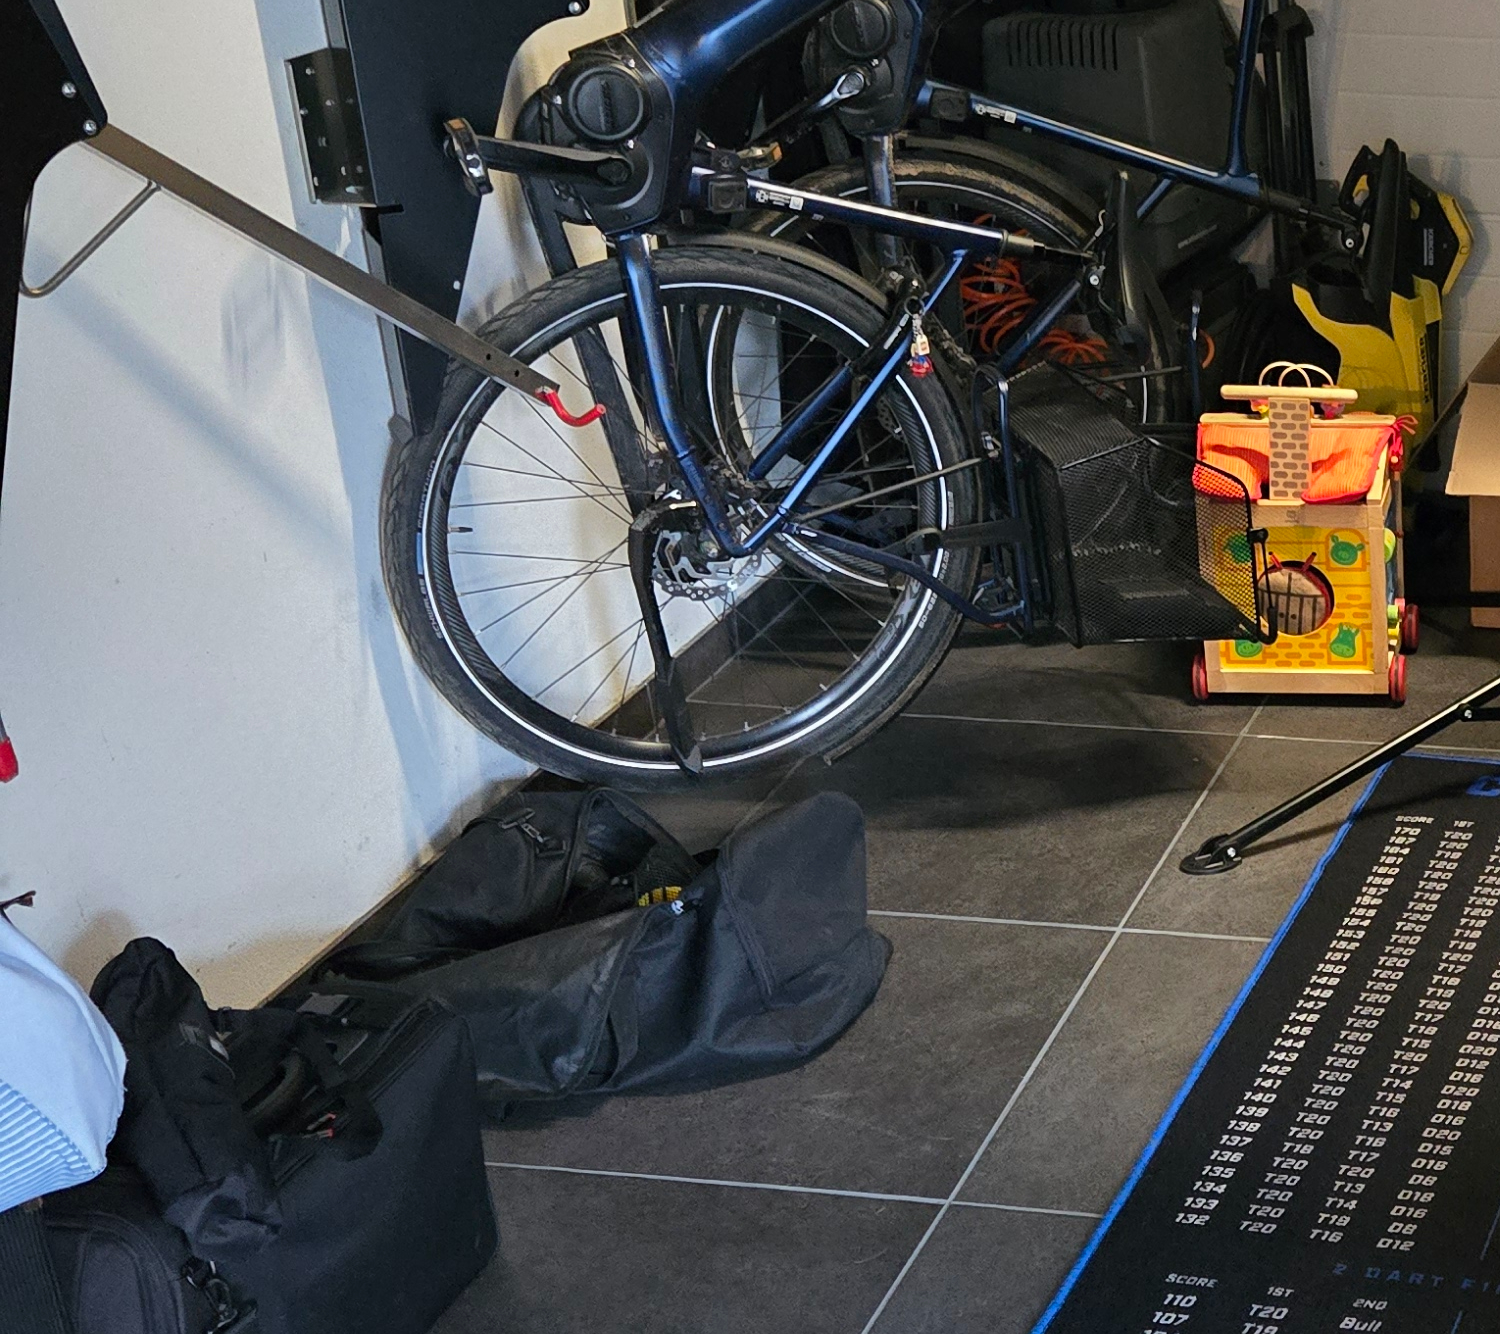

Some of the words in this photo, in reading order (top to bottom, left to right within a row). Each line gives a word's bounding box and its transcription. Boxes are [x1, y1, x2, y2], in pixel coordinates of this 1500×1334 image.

[1165, 1273, 1217, 1288] SCORE
[1267, 1286, 1295, 1297] 1ST
[1353, 1298, 1388, 1311] 2ND
[1332, 1263, 1347, 1276] 2
[1364, 1267, 1444, 1288] DART
[1163, 1293, 1197, 1307] 110
[1249, 1304, 1289, 1320] T20
[1339, 1316, 1382, 1332] Bull
